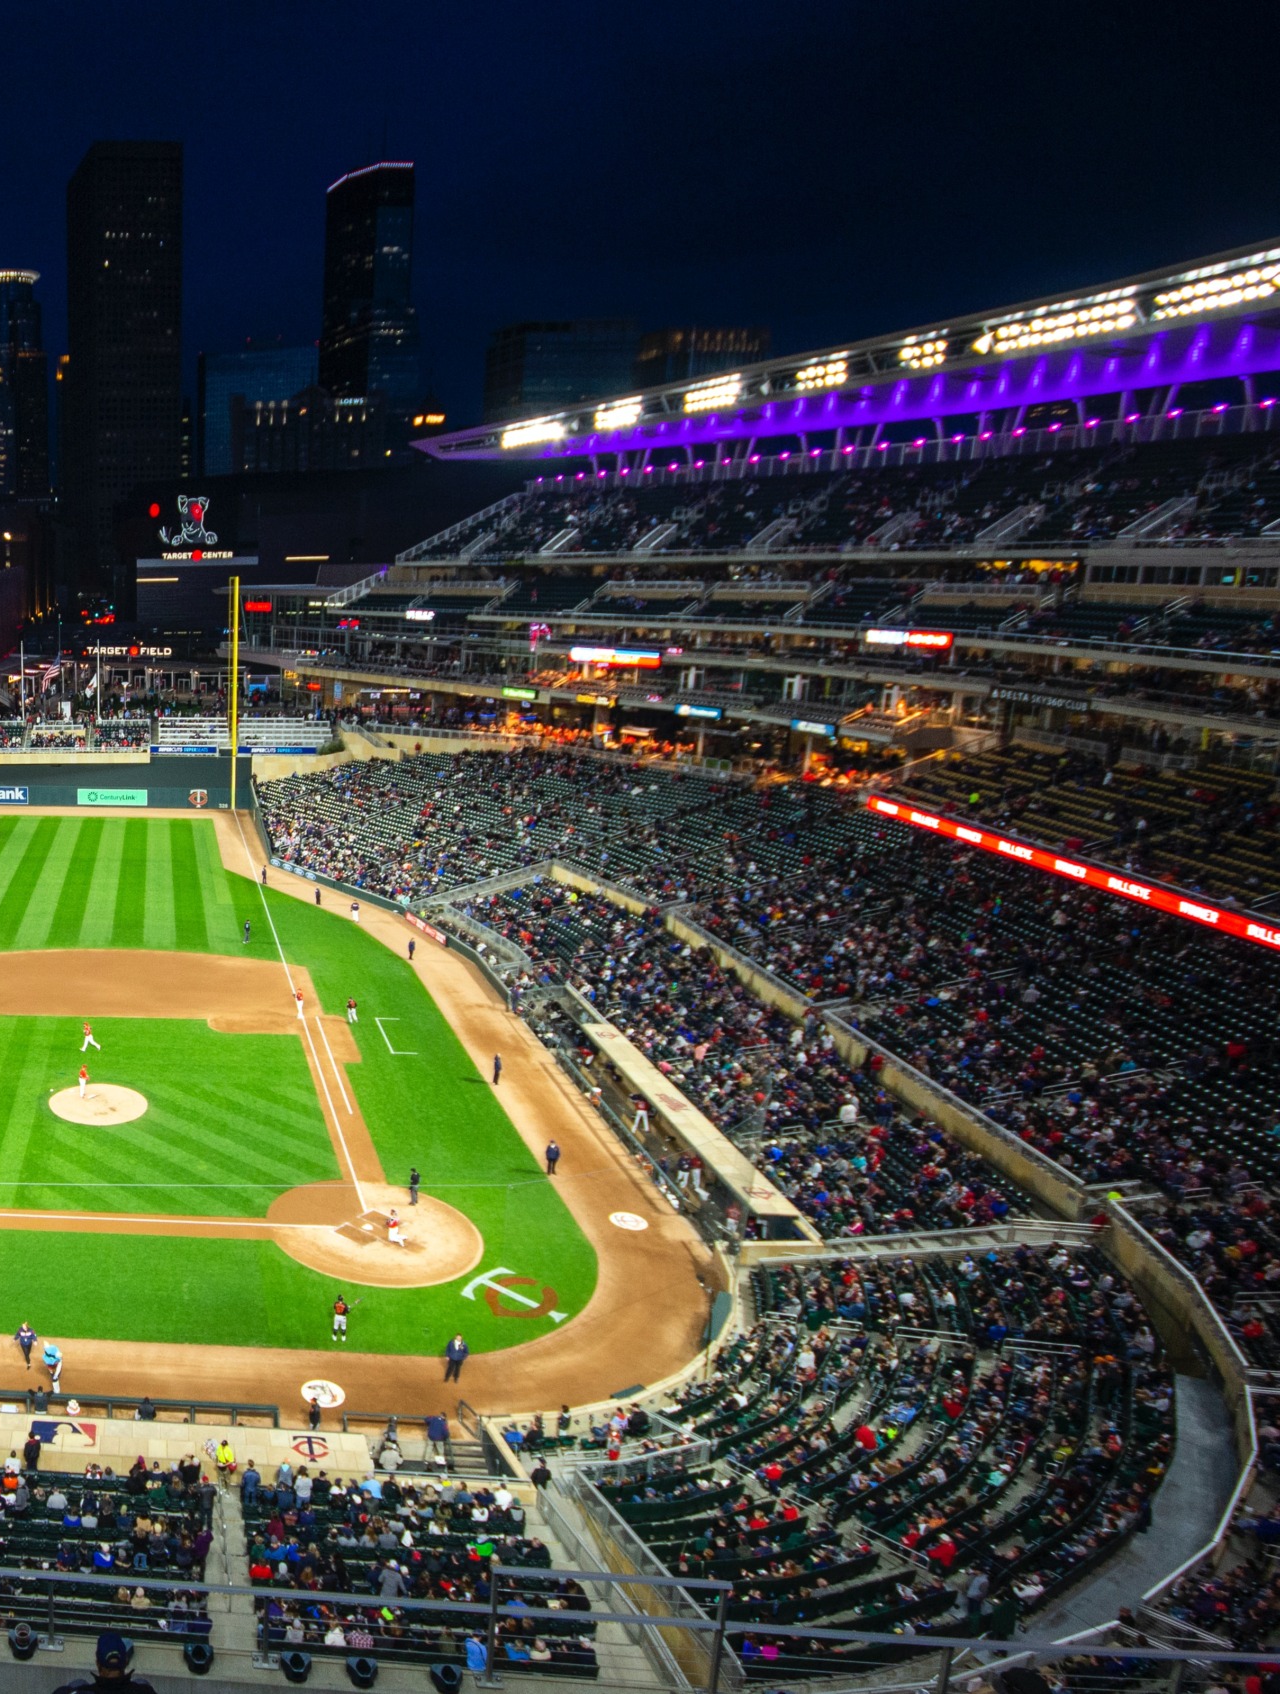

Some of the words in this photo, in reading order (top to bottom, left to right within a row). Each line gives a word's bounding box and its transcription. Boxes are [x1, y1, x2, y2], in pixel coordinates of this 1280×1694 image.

[162, 552, 193, 560] TARGET
[202, 551, 233, 559] CENTER
[86, 646, 128, 655] TARGET
[140, 647, 172, 656] FIELD
[1000, 688, 1029, 702] DELTA
[1065, 699, 1088, 712] CLUB
[99, 793, 136, 801] CenturyLink
[1055, 859, 1087, 879] WINNER
[1108, 876, 1152, 901] BULLSEYE
[1179, 901, 1219, 924] WINNER
